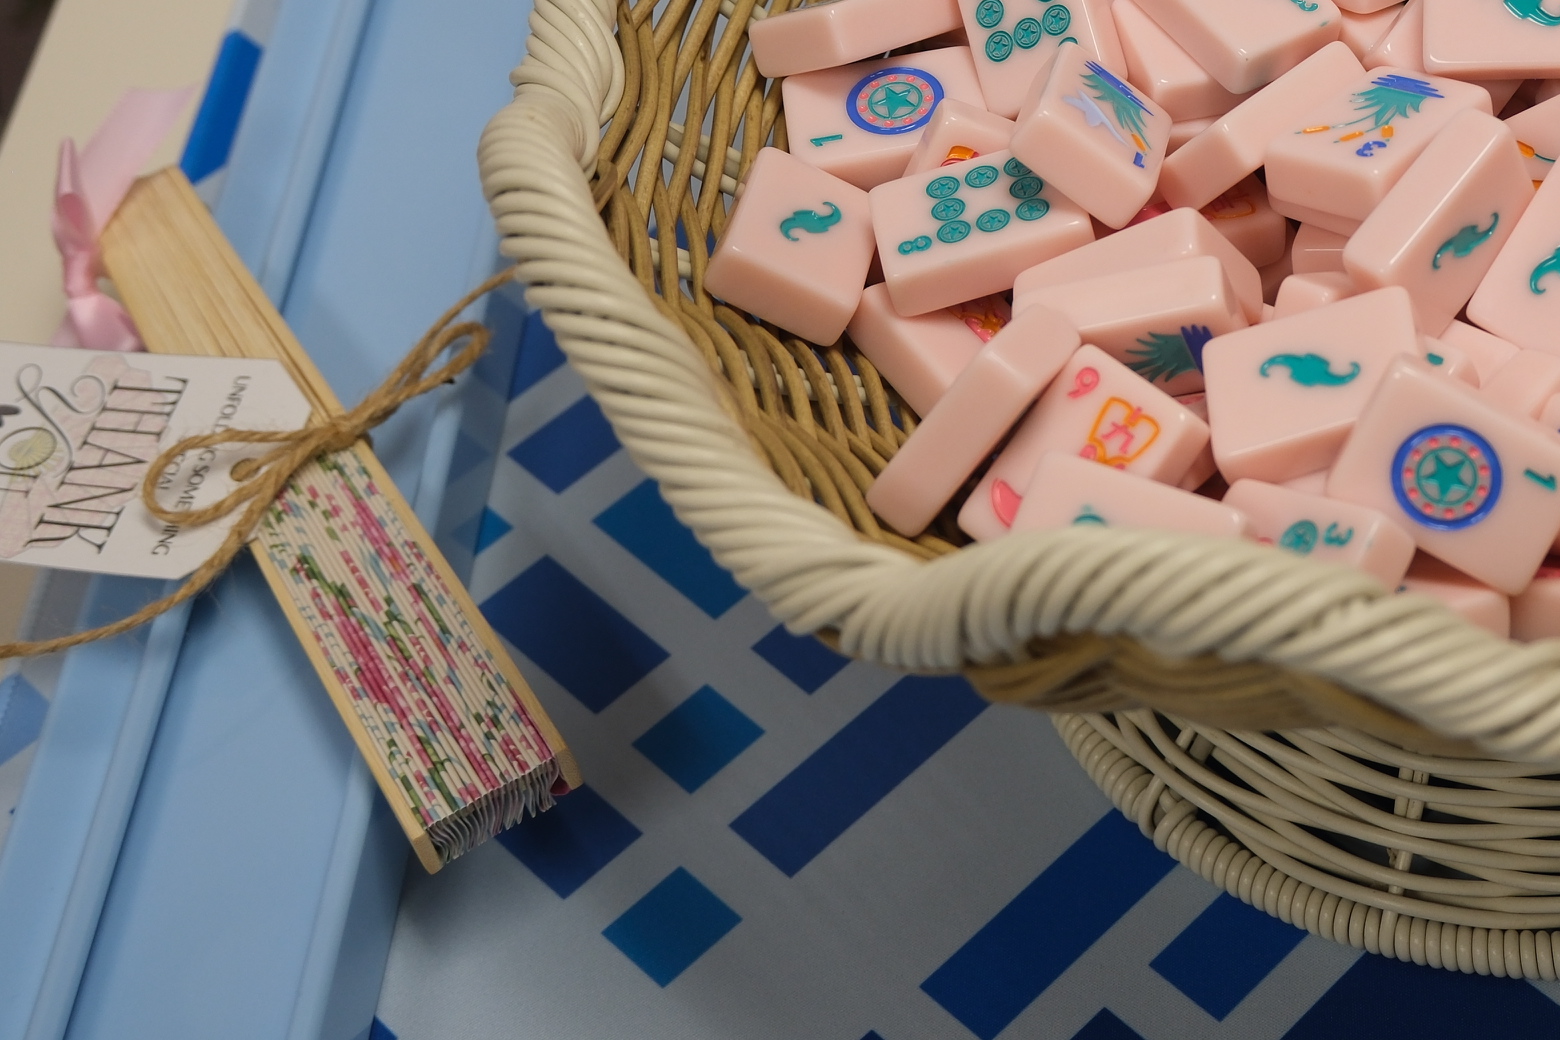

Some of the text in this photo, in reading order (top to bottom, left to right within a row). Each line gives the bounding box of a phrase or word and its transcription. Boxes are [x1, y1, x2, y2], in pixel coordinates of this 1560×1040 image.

[809, 133, 843, 147] 1
[897, 234, 933, 257] 8
[1067, 366, 1100, 400] 9
[23, 376, 190, 555] THANK
[1522, 467, 1560, 491] 1
[1323, 521, 1355, 549] 3
